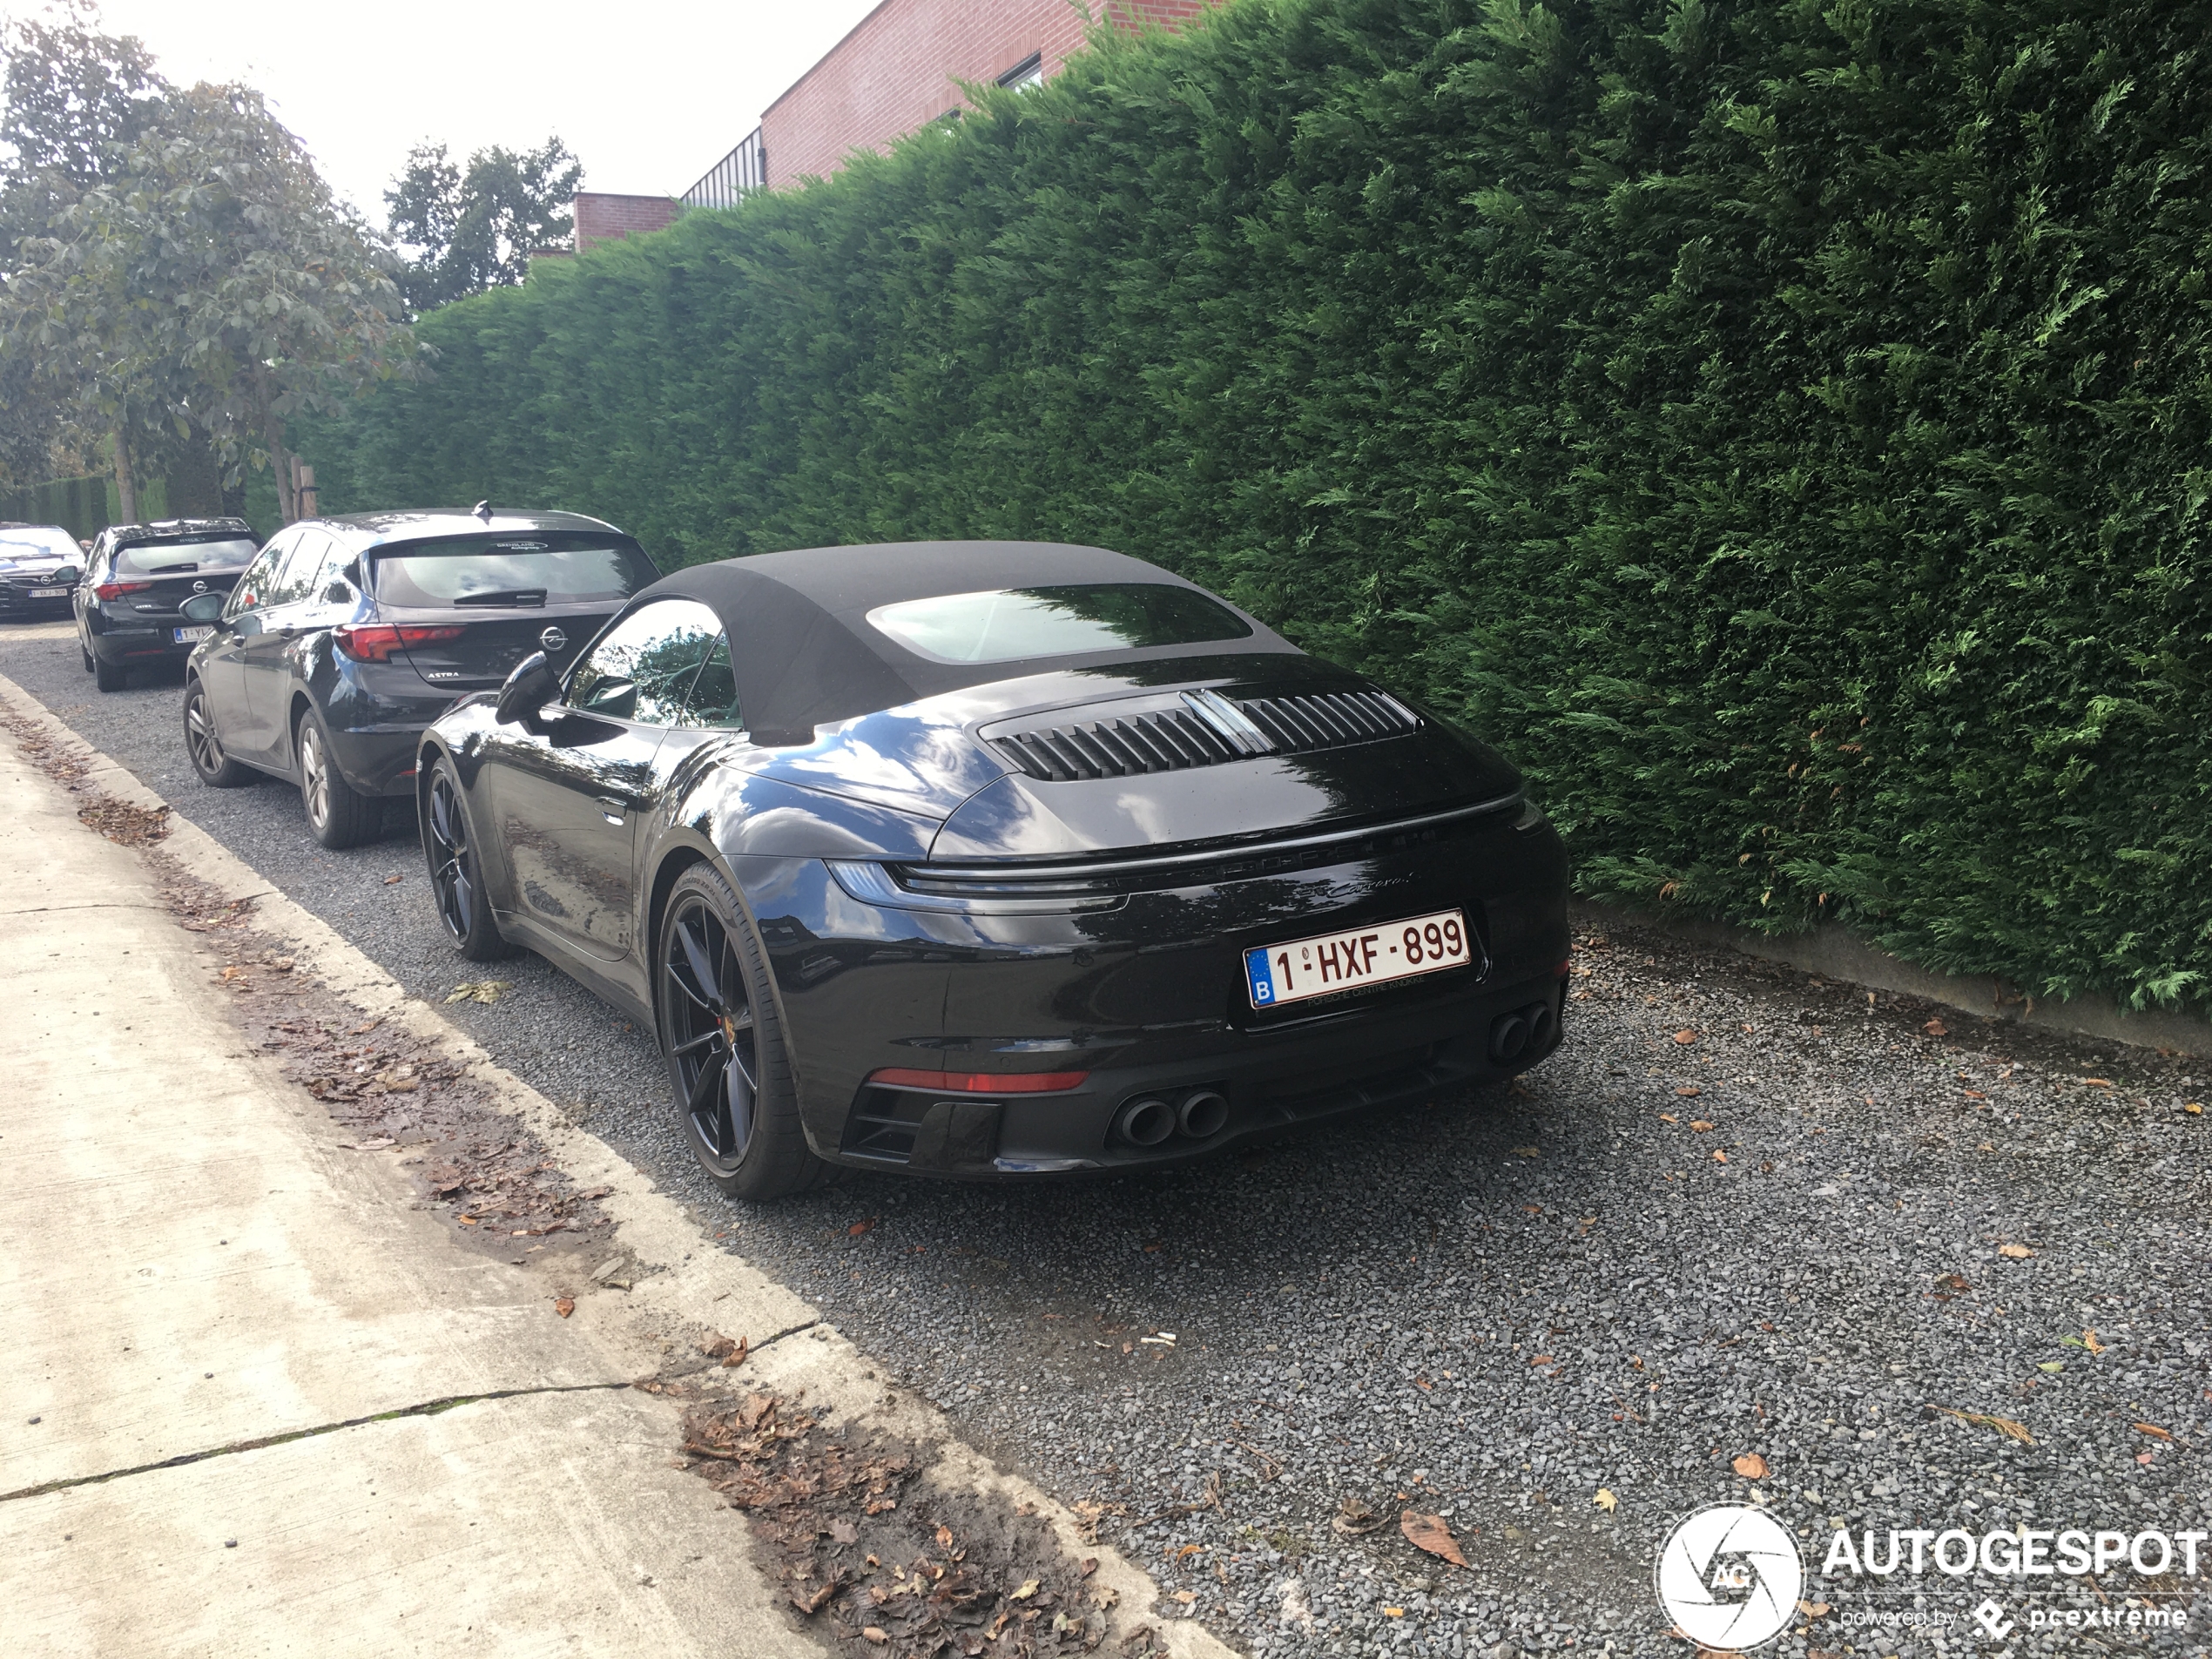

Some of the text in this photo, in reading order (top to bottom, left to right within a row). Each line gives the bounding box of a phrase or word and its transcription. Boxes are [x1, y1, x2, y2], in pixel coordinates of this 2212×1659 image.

[1326, 878, 1405, 898] Carrera
[1278, 919, 1462, 991] 1-HXF-899
[1256, 981, 1270, 1000] B
[1307, 975, 1425, 1007] PORSCHE CENTRE KNOKKE
